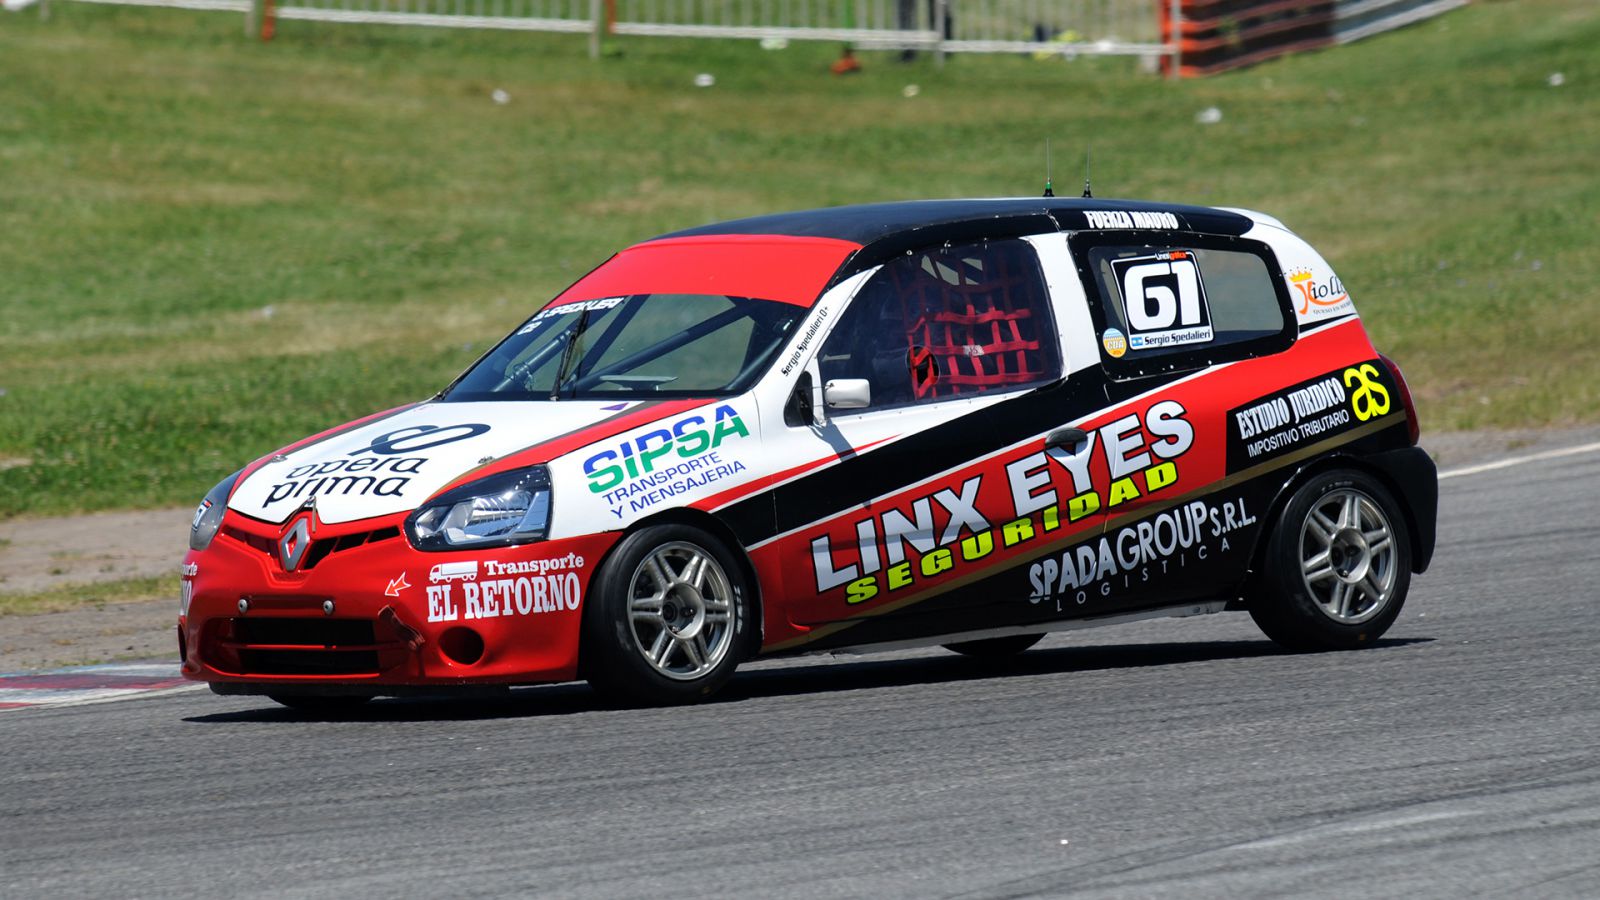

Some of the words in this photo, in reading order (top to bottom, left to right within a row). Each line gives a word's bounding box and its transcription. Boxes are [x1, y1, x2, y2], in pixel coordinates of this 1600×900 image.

[1083, 210, 1134, 229] FUERZA
[1129, 211, 1179, 230] MAURO
[1124, 260, 1201, 331] 61
[780, 351, 802, 377] Sergio
[797, 314, 825, 353] Spedalieri
[1144, 335, 1170, 346] Sergio
[1171, 329, 1211, 342] Spedalieri
[1236, 397, 1291, 440] ESTUDIO
[1288, 377, 1346, 424] JURIDICO
[1247, 429, 1300, 458] IMPOSITIVO
[1300, 409, 1350, 439] TRIBUTARIO
[286, 456, 429, 479] opera
[583, 404, 750, 494] SIPSA
[262, 475, 412, 508] prima
[602, 451, 723, 505] TRANSPORTE
[611, 505, 623, 519] Y
[629, 460, 747, 512] MENSAJERIA
[811, 474, 992, 593] LINX
[1005, 400, 1194, 518] EYES
[845, 461, 1179, 605] SEGURIDAD
[1210, 497, 1257, 537] S.R.L.
[484, 552, 585, 576] Transporte
[1056, 537, 1231, 613] LOGISTICA
[426, 584, 458, 623] EL
[463, 572, 581, 620] RETORNO
